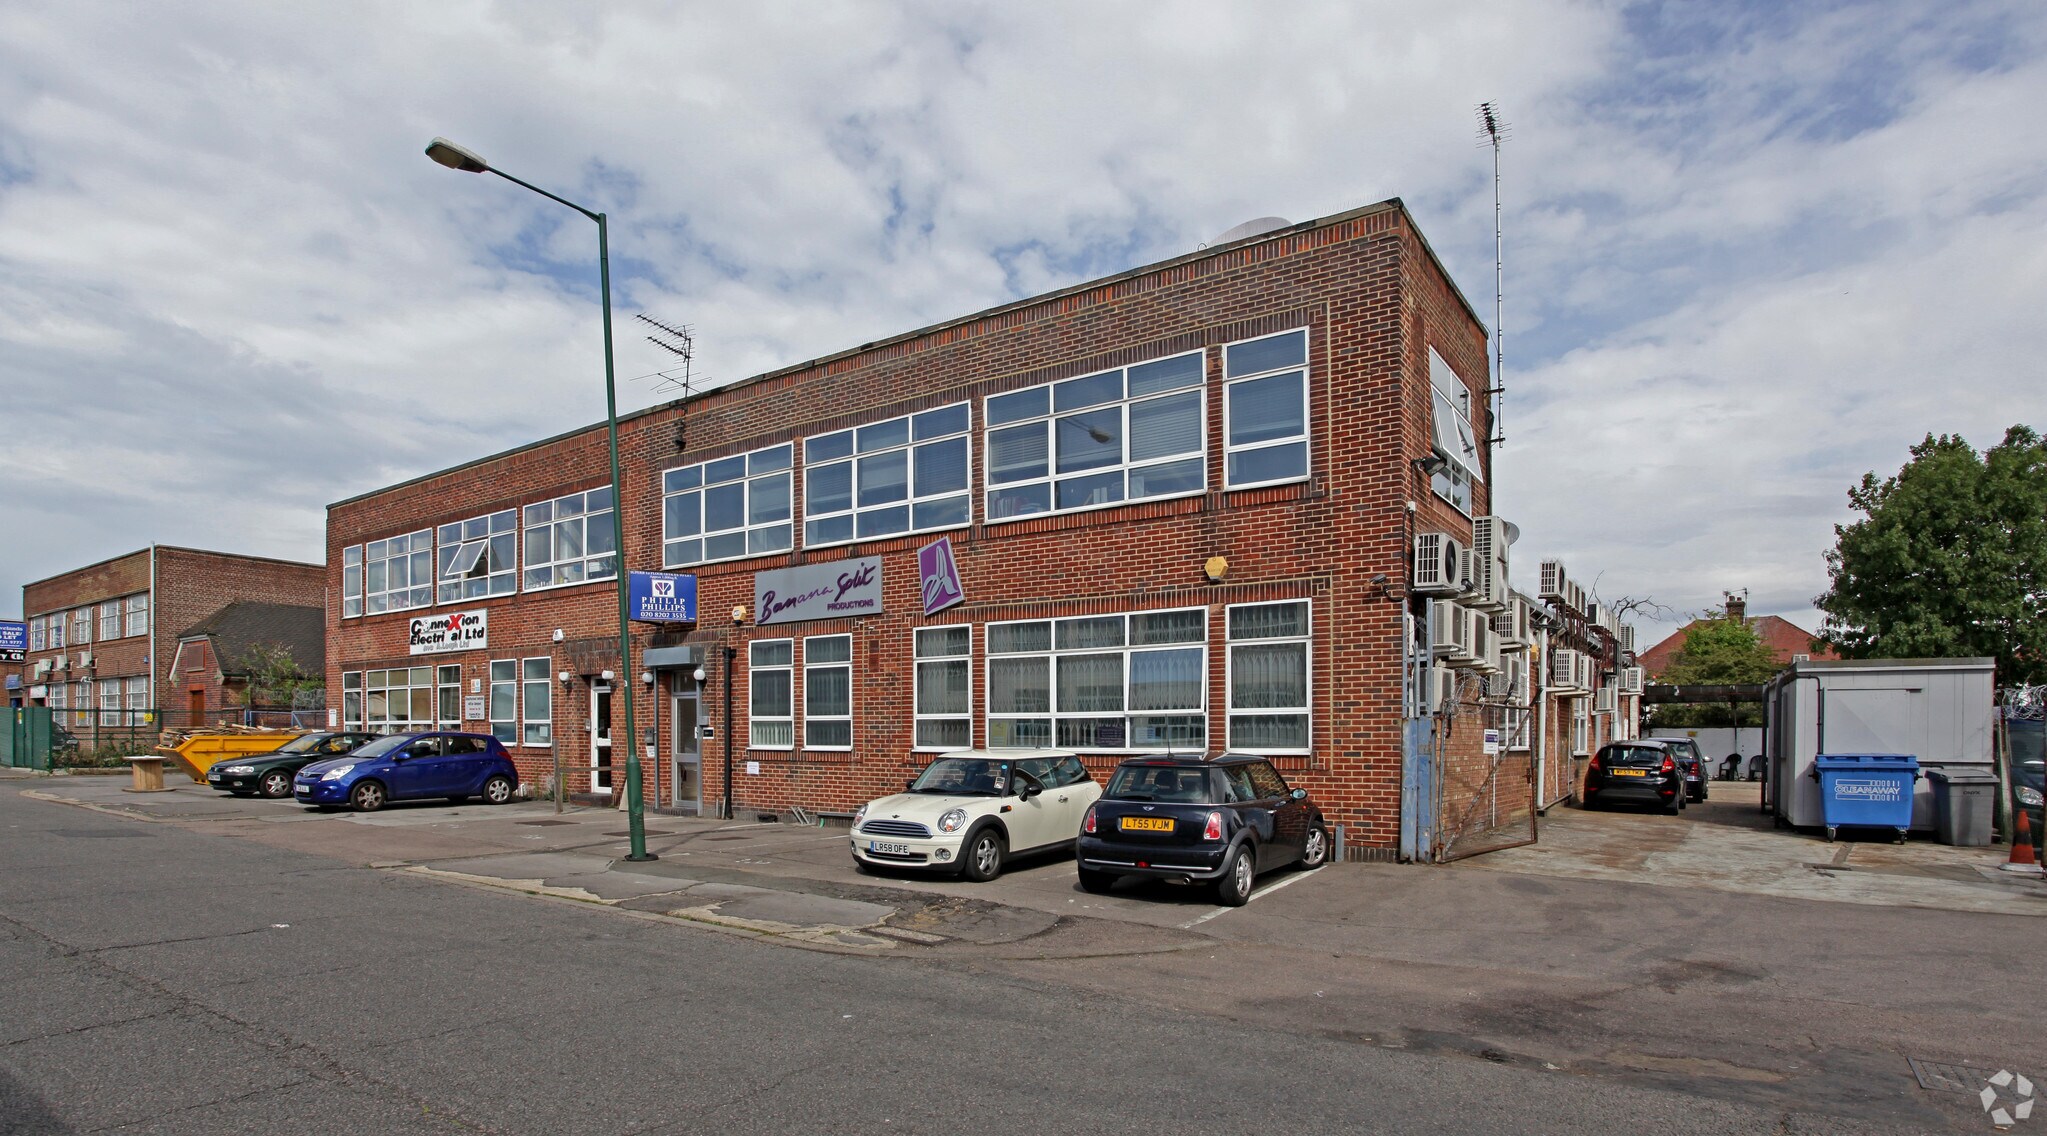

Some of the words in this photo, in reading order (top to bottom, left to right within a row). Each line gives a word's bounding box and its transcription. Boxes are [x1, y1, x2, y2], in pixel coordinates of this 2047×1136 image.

[757, 586, 833, 624] Banana
[834, 562, 876, 602] Split
[642, 597, 685, 605] PHILIP
[827, 599, 874, 611] PRODUCTIONS
[465, 627, 485, 640] Ltd
[1834, 785, 1900, 795] CLEANAWAY
[1125, 819, 1149, 829] LT55
[1152, 820, 1170, 829] VJM
[875, 841, 893, 852] LR58
[894, 844, 909, 854] OFE
